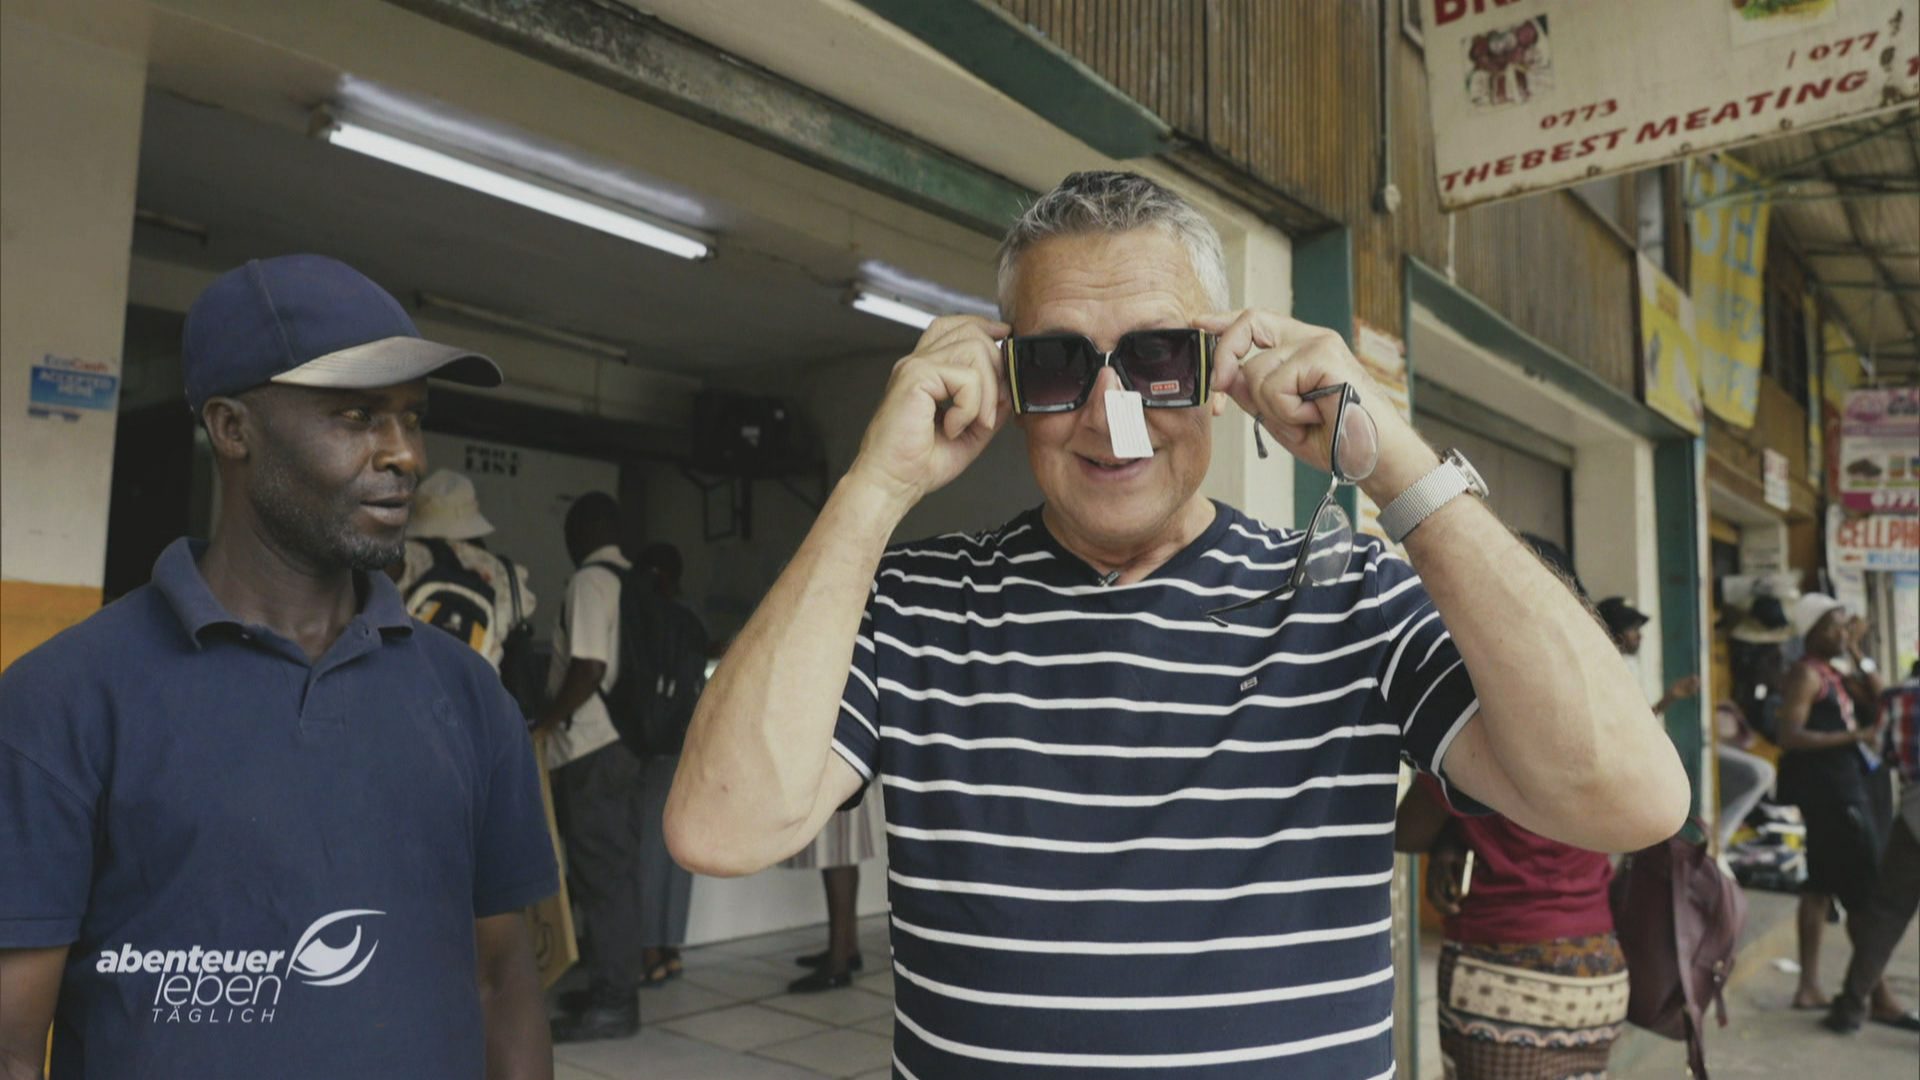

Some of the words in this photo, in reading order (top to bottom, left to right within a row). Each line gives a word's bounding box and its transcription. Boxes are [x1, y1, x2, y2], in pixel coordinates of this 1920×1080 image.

[1441, 127, 1627, 192] THEBEST
[1635, 70, 1868, 144] MEATING
[1540, 99, 1618, 130] 0773
[1809, 31, 1878, 61] 077
